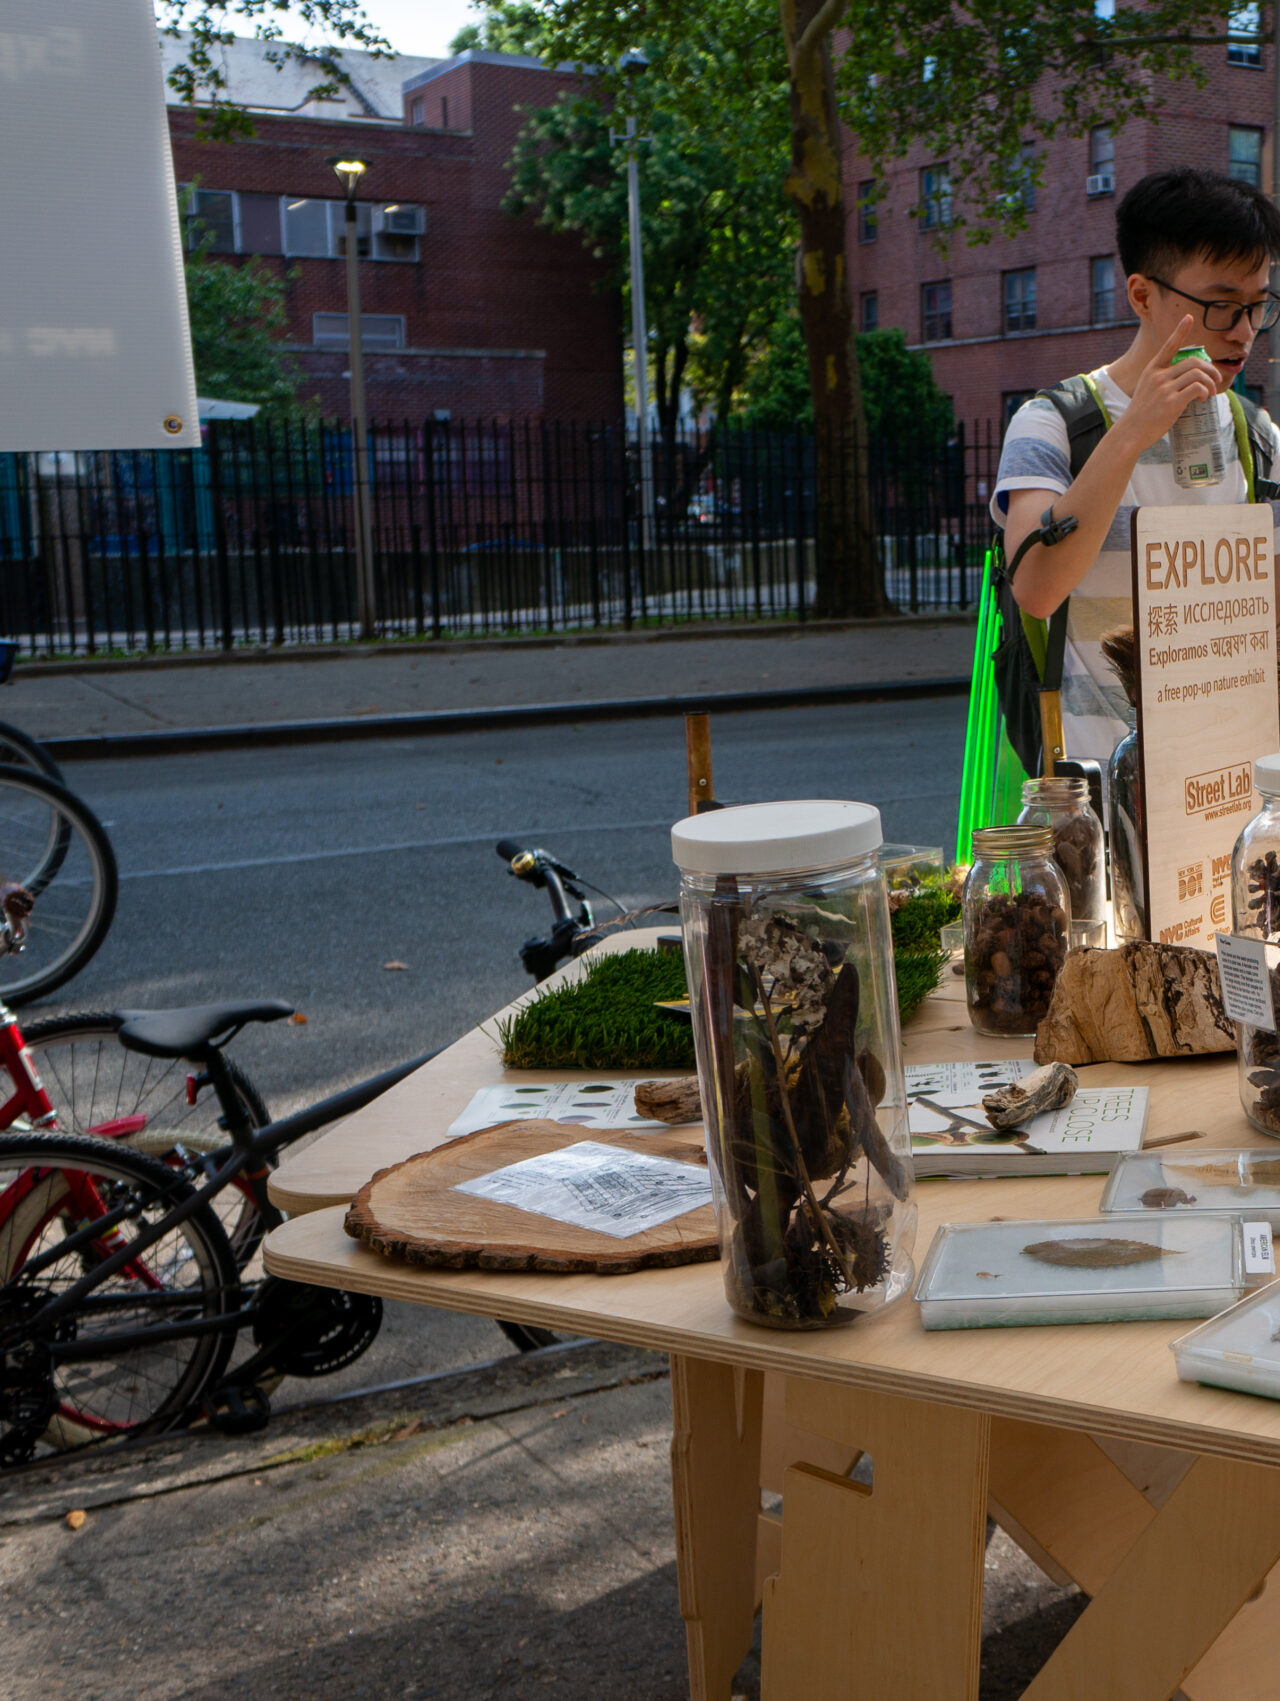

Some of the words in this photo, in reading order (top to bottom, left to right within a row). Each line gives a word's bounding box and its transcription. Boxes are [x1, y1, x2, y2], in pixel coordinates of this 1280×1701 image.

[1145, 536, 1268, 590] EXPLORE
[1147, 602, 1179, 639] 探索
[1183, 596, 1269, 625] исследовать
[1149, 644, 1208, 669] Exploramos
[1210, 633, 1248, 659] অন্বেষণ
[1249, 630, 1269, 652] করা
[1157, 690, 1163, 703] a
[1164, 683, 1181, 701] free
[1182, 680, 1212, 702] pop-up
[1213, 675, 1238, 692] nature
[1239, 668, 1265, 688] exhibit
[1186, 774, 1226, 811] Street
[1228, 767, 1250, 798] Lab
[1204, 799, 1252, 822] www.streetlab.org
[1178, 872, 1203, 901] DOT
[1159, 922, 1184, 945] NYC
[1184, 913, 1203, 929] Cultural
[1184, 926, 1200, 939] Affairs
[1075, 1090, 1105, 1105] UP
[1101, 1088, 1135, 1122] TREES
[1061, 1106, 1099, 1143] CLOSE
